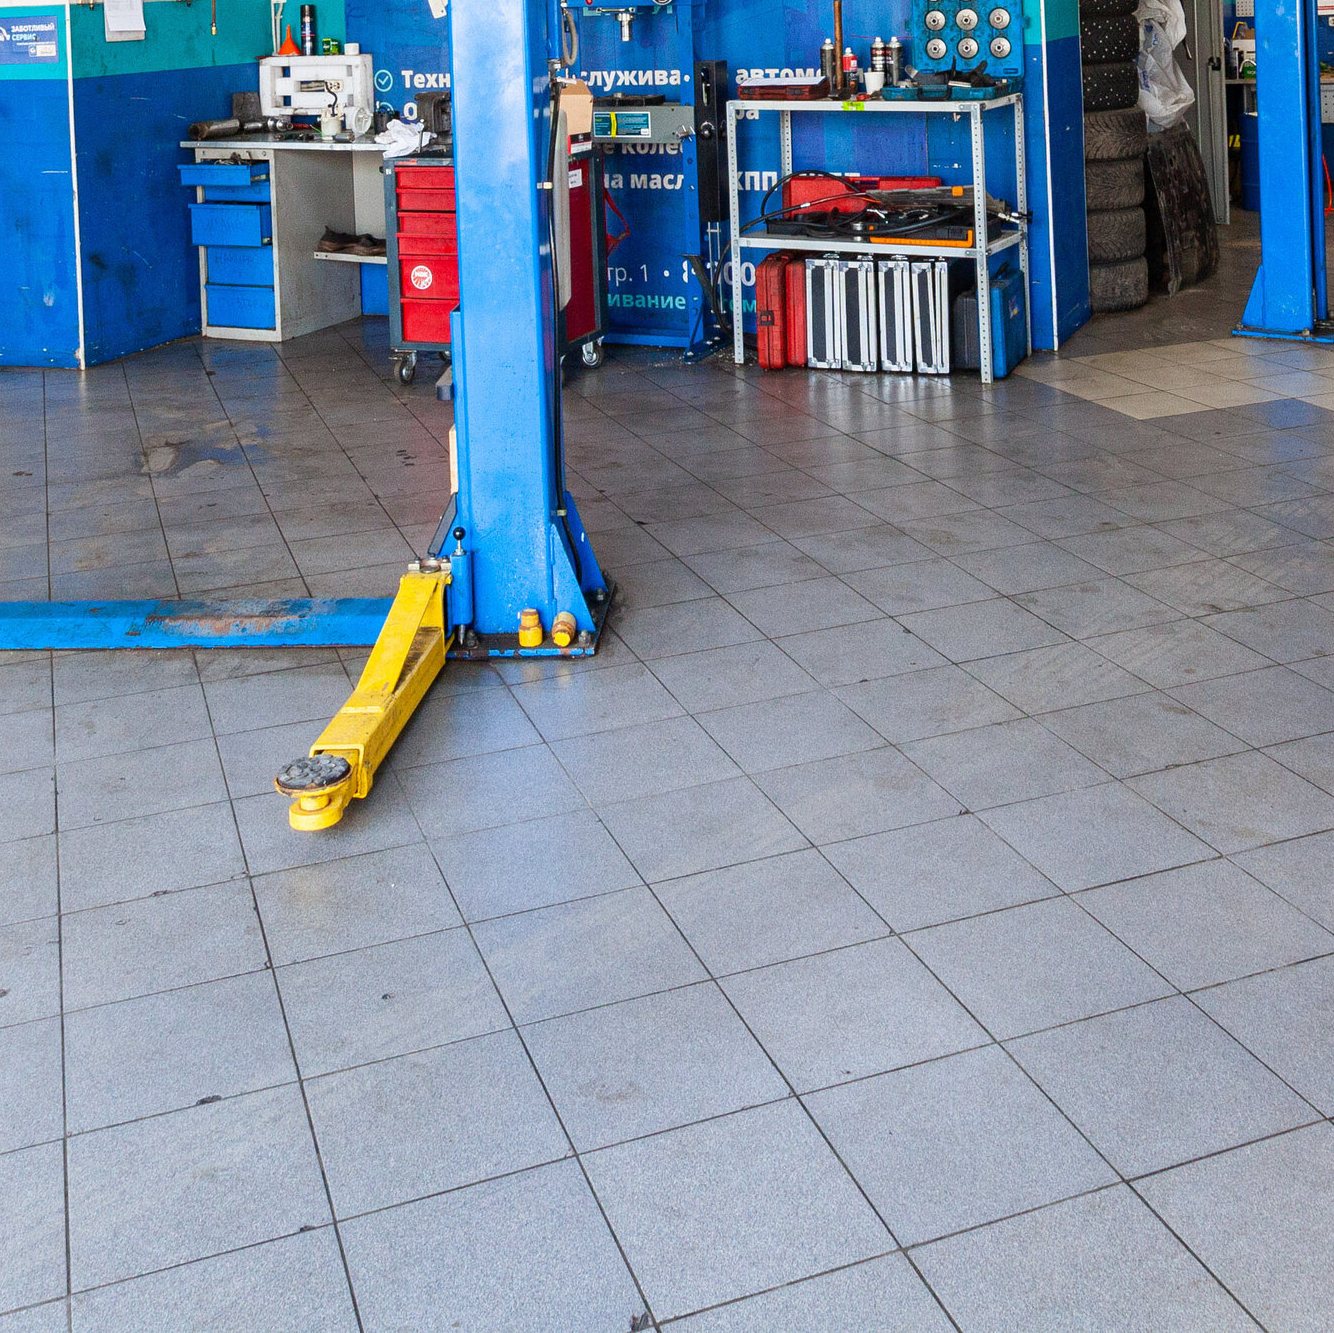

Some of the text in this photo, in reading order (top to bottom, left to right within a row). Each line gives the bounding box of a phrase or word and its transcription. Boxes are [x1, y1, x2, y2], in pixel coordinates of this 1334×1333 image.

[401, 70, 451, 88] Техн
[630, 173, 684, 190] масл
[607, 293, 686, 310] ивание
